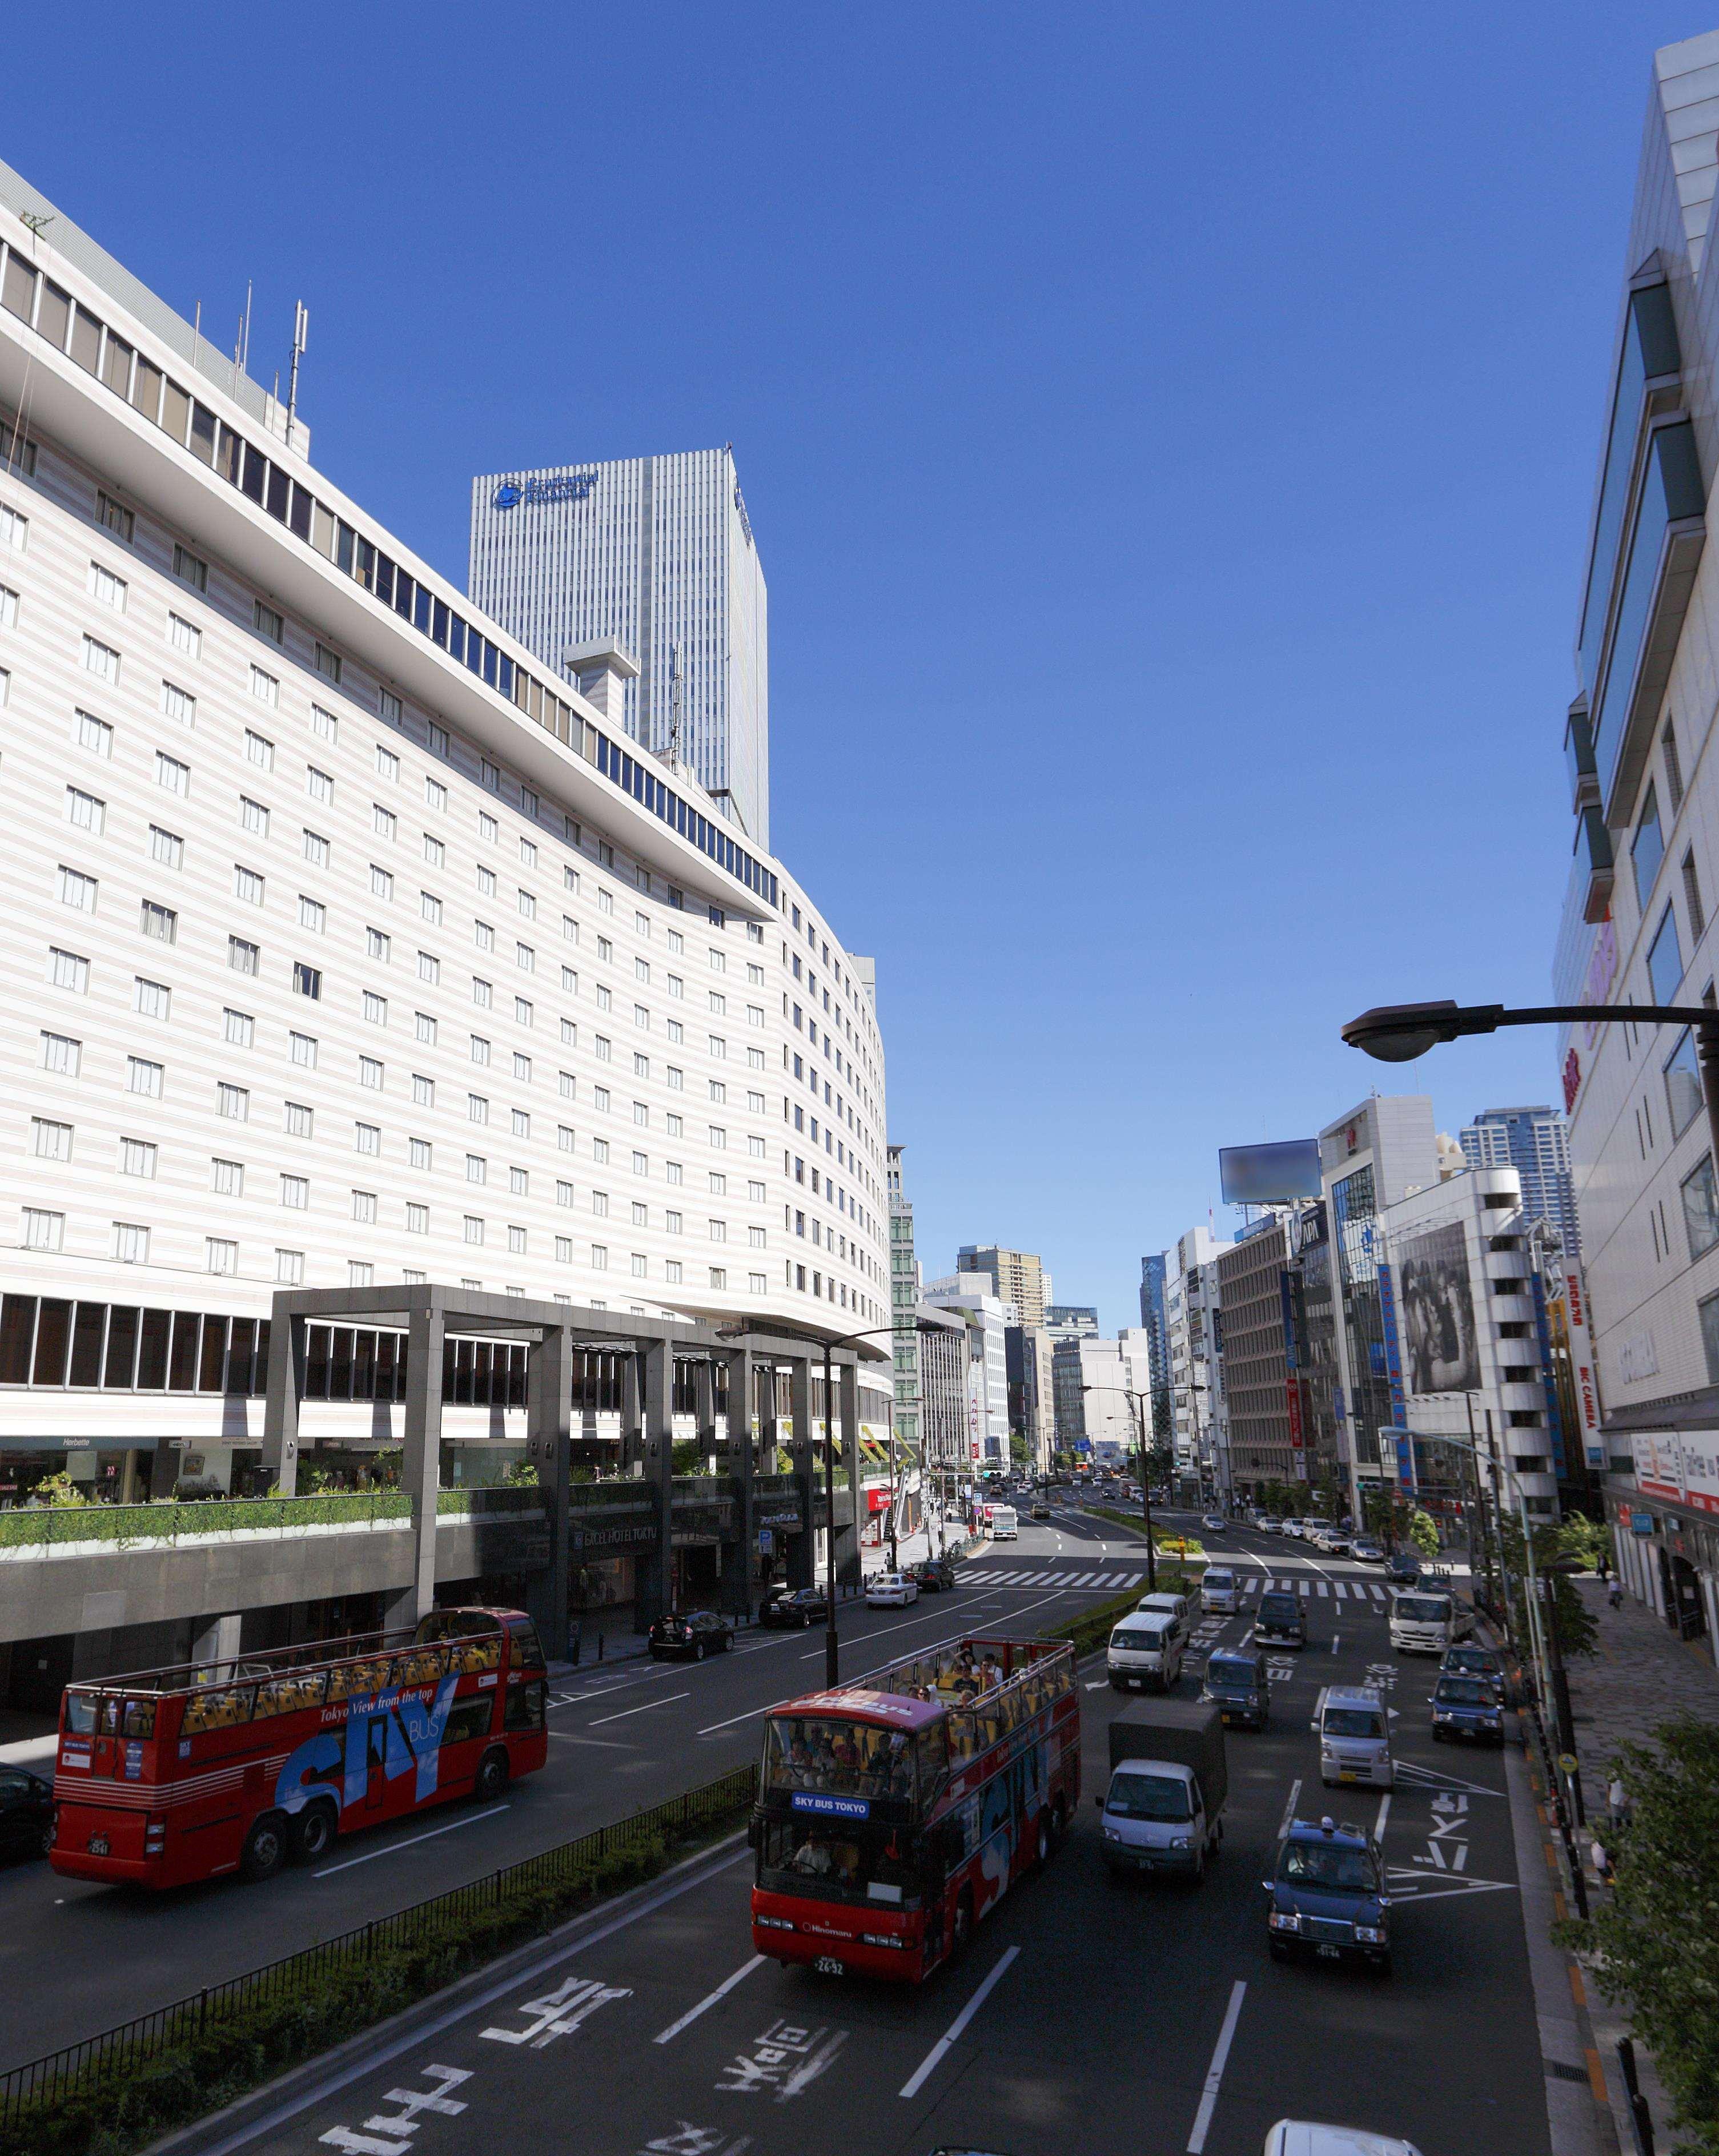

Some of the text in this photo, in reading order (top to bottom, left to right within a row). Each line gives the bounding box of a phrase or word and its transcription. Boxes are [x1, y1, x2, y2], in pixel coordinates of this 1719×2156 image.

[1580, 1367, 1596, 1429] BIC CAMERA
[63, 1438, 90, 1447] Herbette
[320, 1688, 433, 1723] Tokyo View from the top
[409, 1715, 440, 1743] BUS
[794, 1796, 866, 1814] SKY BUS TOKYO
[812, 1924, 852, 1938] Hinomaru
